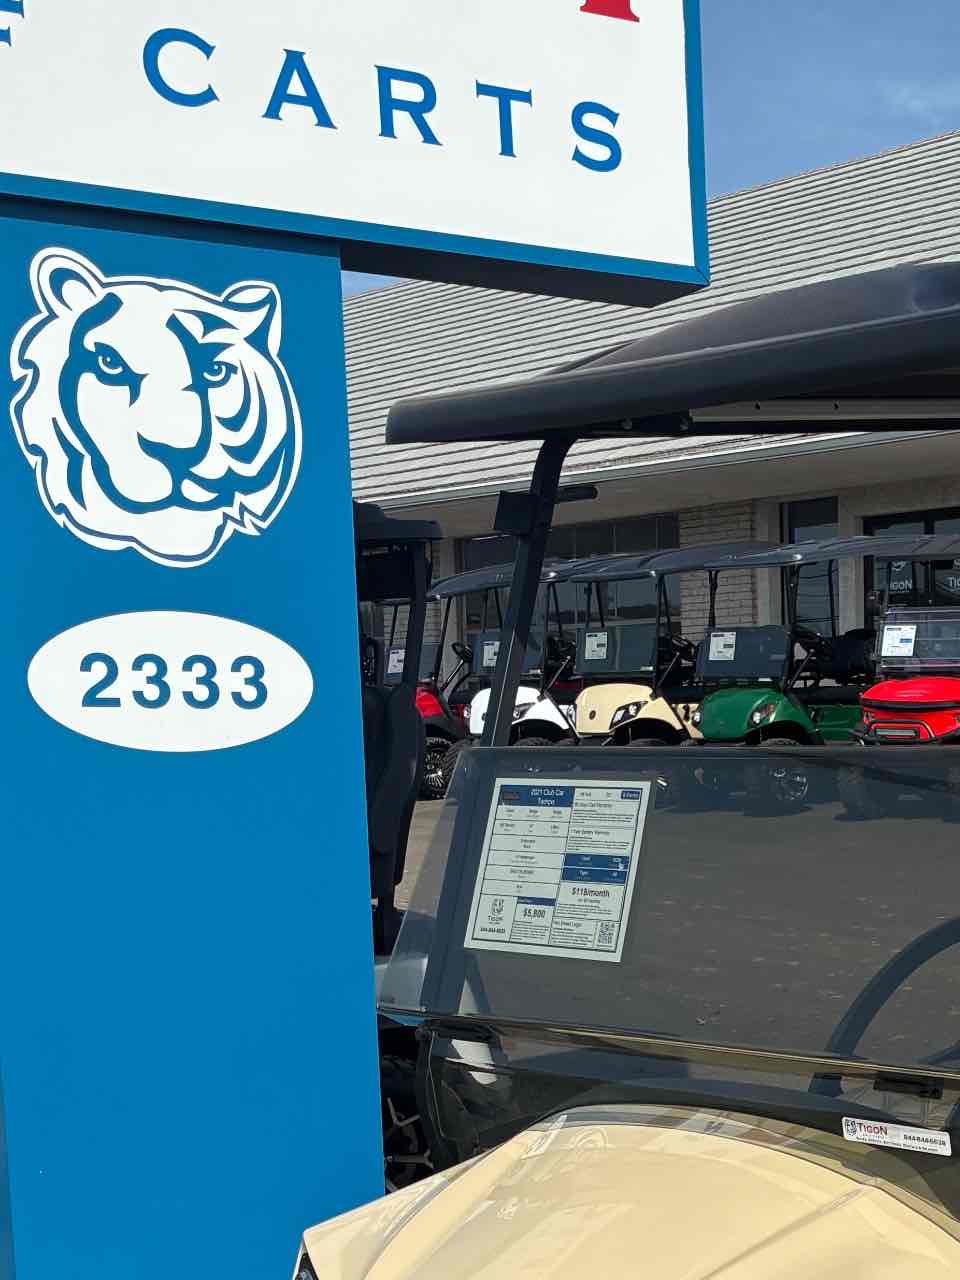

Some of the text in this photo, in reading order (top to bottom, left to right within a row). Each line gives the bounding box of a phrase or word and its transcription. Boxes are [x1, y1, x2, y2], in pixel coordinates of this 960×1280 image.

[142, 27, 625, 174] CARTS
[889, 579, 913, 590] IGON
[79, 652, 269, 711] 2333
[857, 1122, 888, 1136] TIGON
